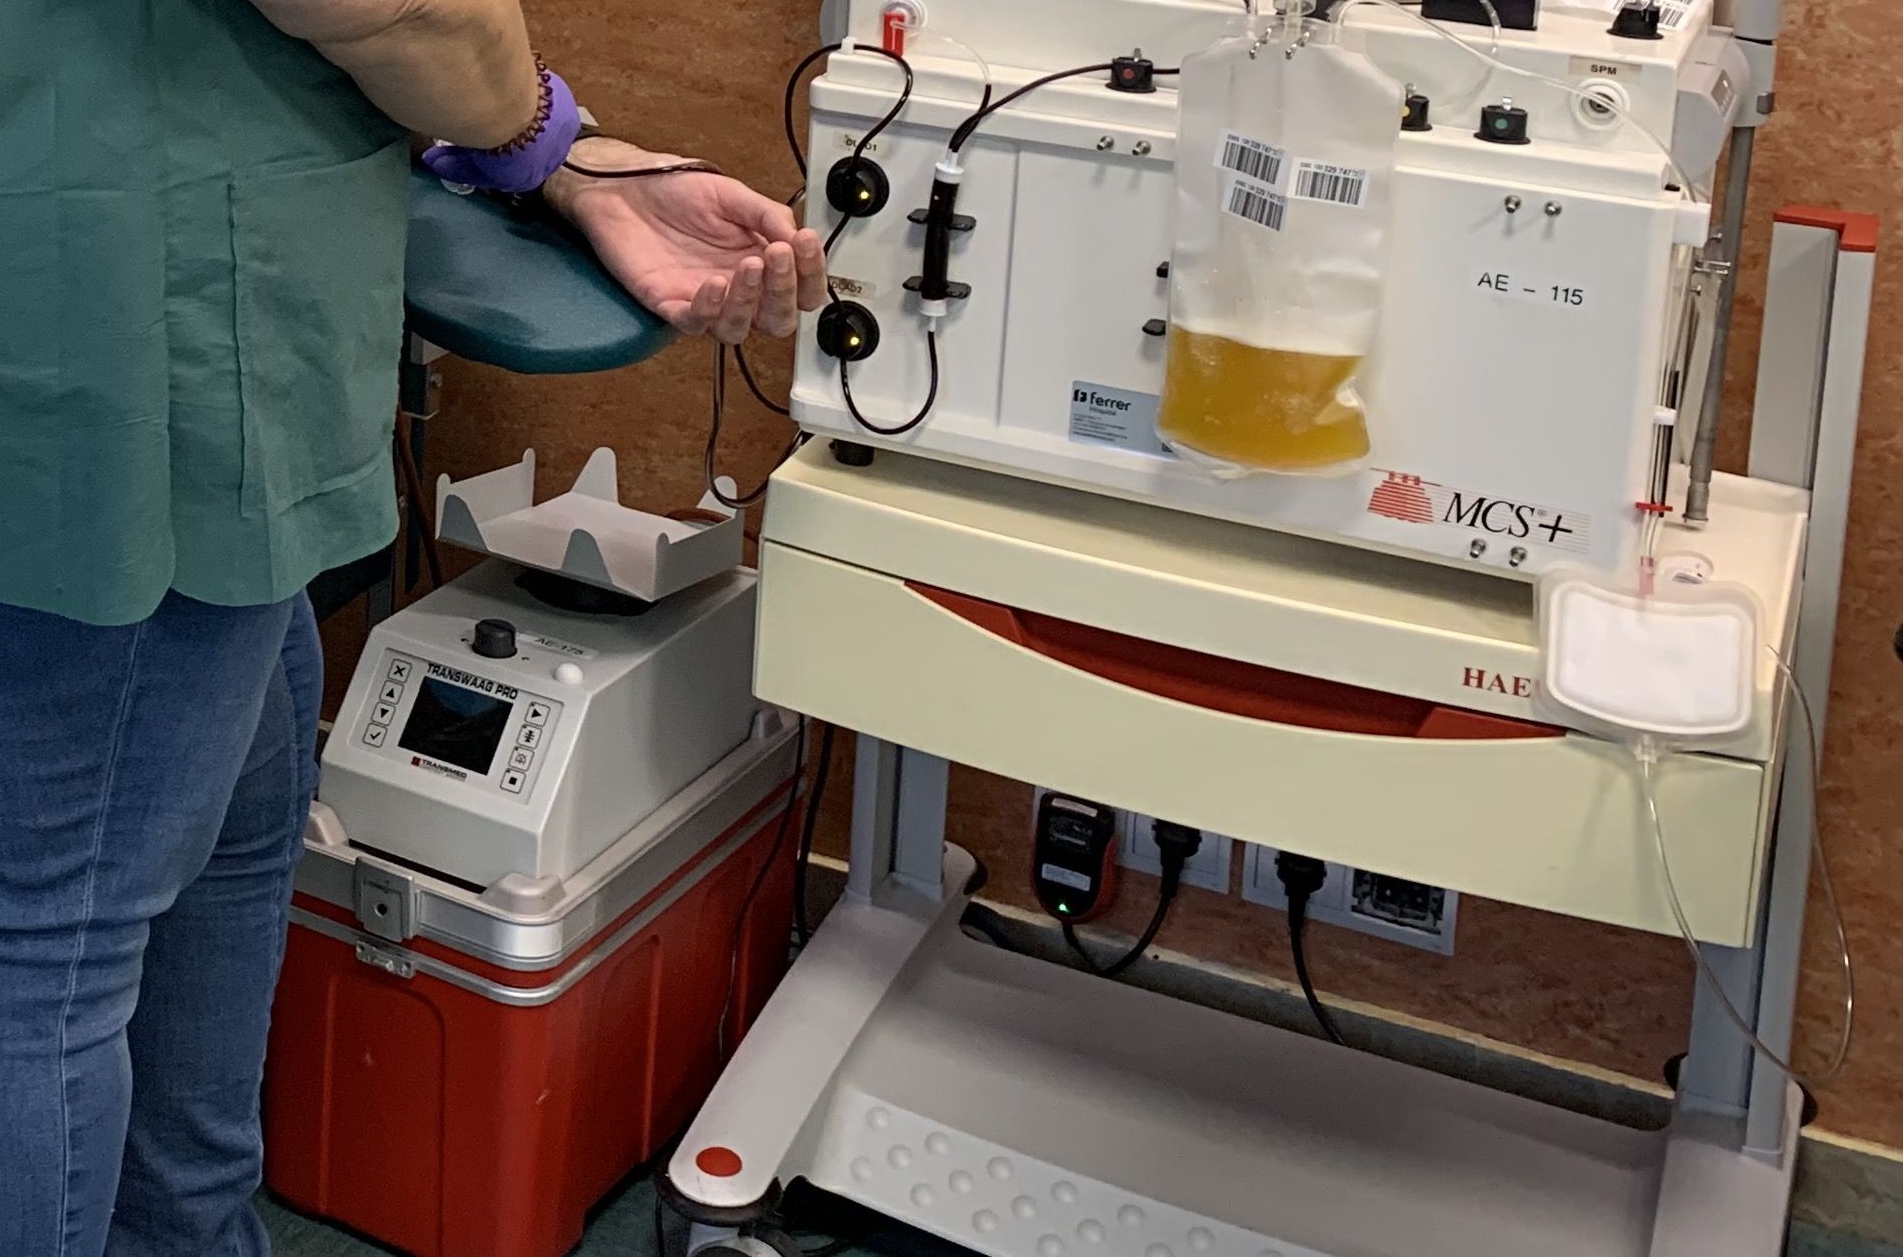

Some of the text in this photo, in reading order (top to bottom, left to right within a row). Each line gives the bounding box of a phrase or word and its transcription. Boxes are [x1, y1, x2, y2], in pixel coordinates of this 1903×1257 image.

[1590, 64, 1618, 75] SPM
[1477, 271, 1510, 293] AE
[1550, 284, 1584, 306] 115
[1090, 391, 1132, 411] ferrer
[426, 662, 519, 701] TRANSWAAG PRO
[421, 758, 468, 779] TRANSMED
